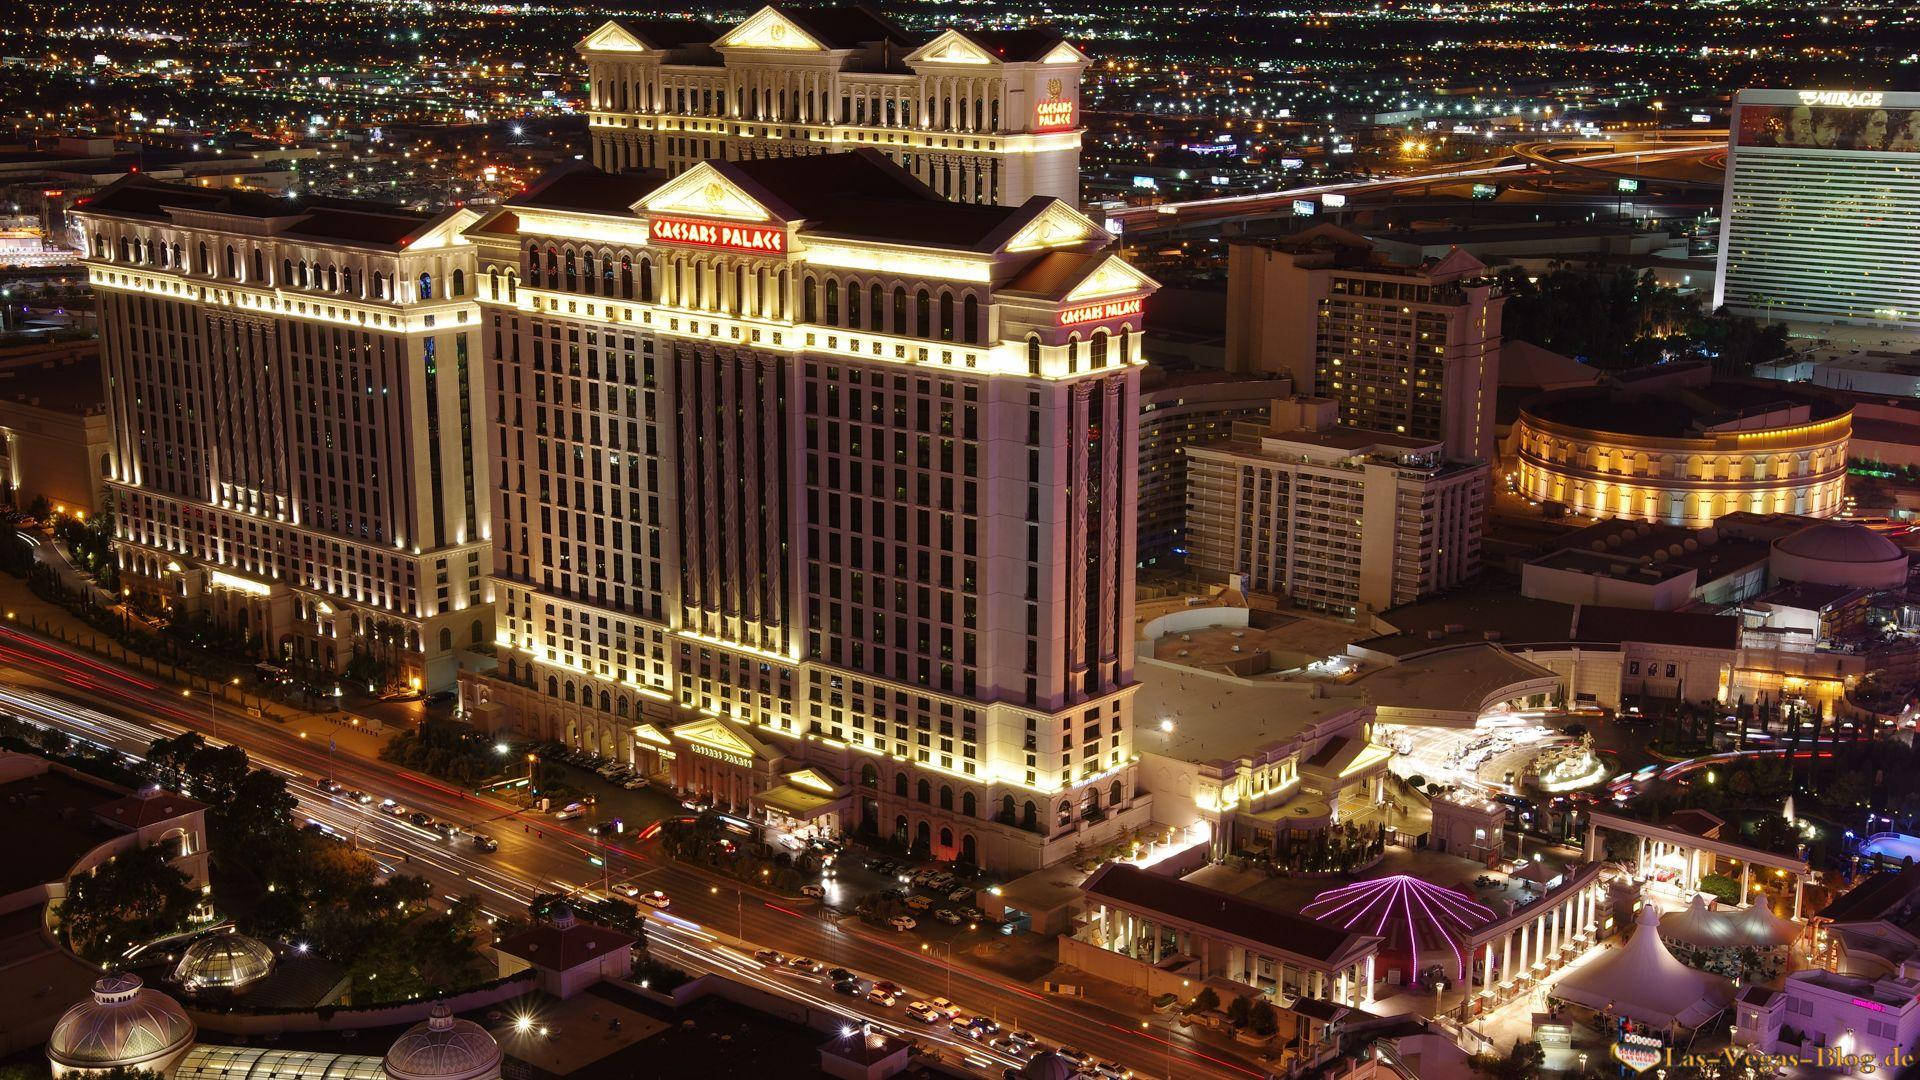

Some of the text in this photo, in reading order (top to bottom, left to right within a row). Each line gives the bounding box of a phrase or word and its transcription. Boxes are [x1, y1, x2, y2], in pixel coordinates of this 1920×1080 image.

[1037, 101, 1073, 114] CAESARS
[1803, 91, 1884, 108] MIRAGE
[1038, 113, 1071, 126] PALACE
[653, 220, 781, 251] CAESARS PALACE
[1060, 299, 1140, 325] CAESARS PALACE
[690, 743, 723, 760] CAESARS
[724, 752, 753, 769] PALACE
